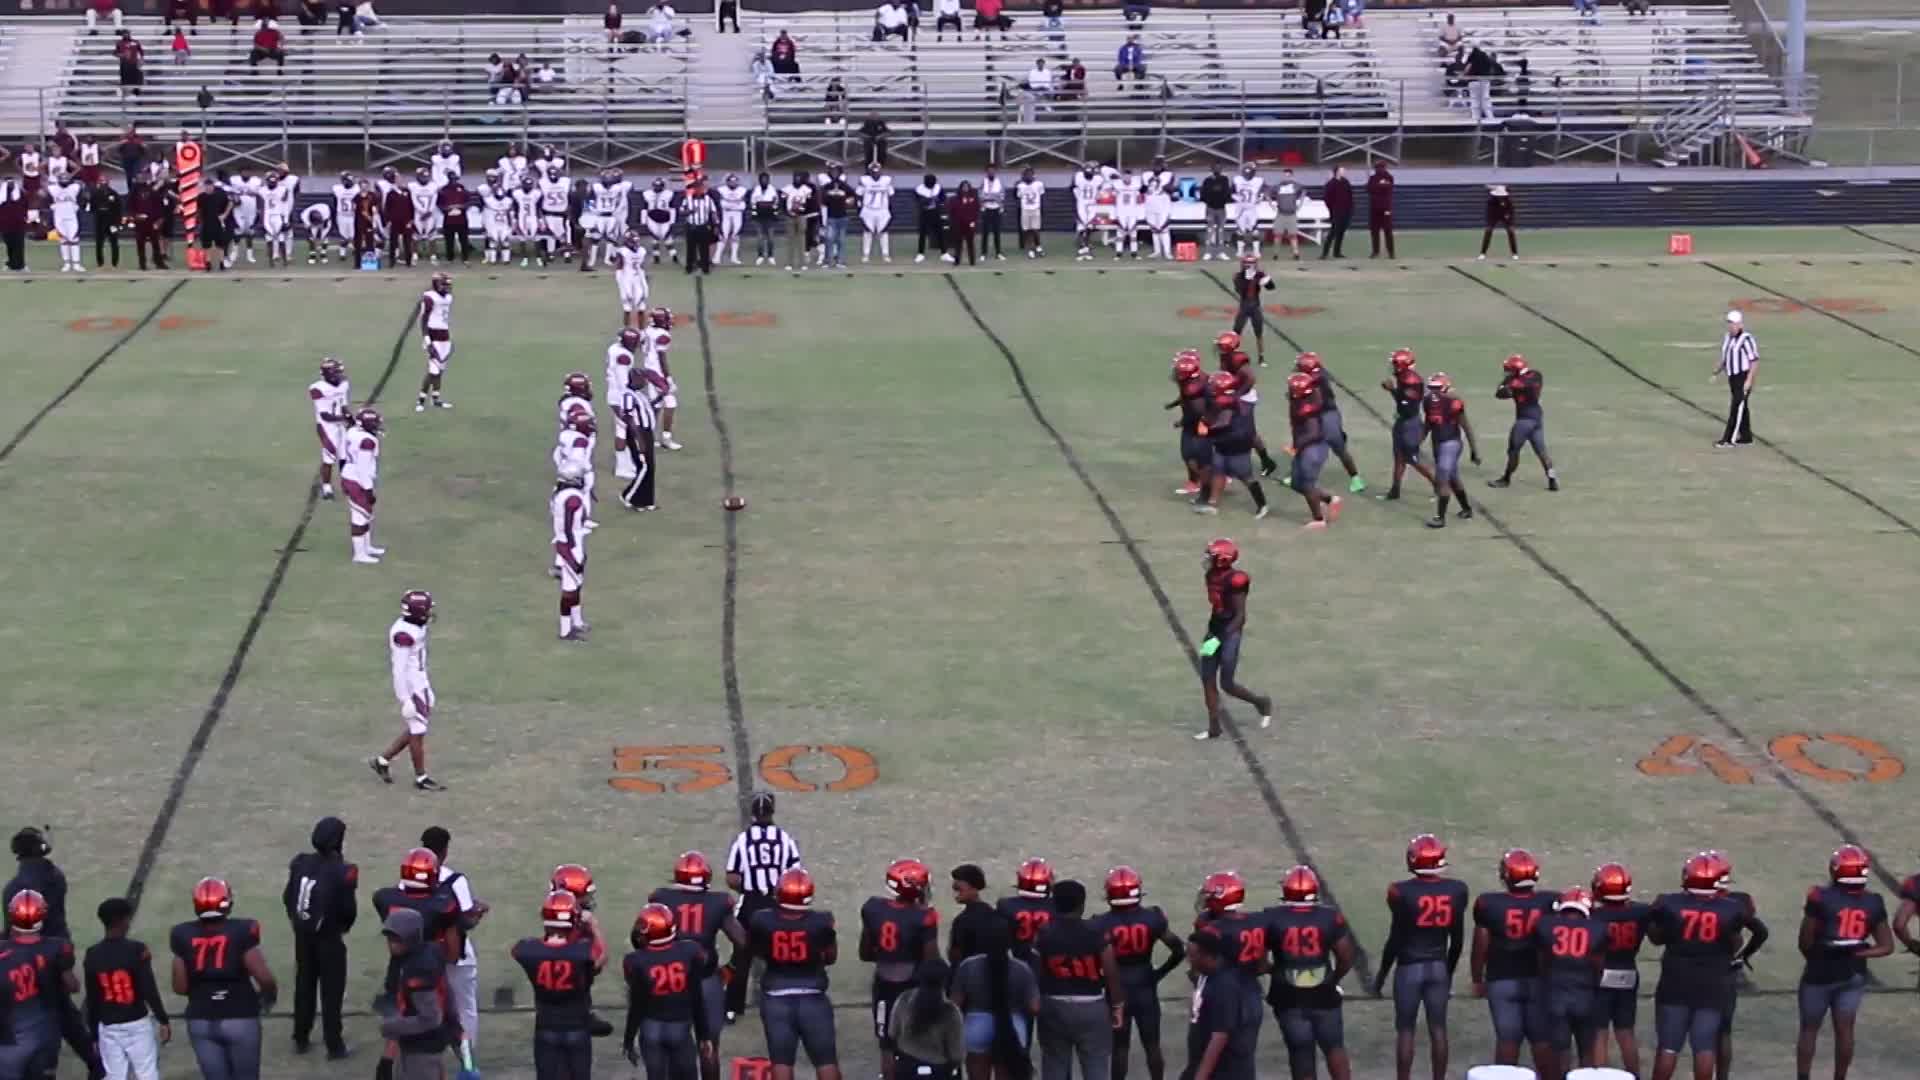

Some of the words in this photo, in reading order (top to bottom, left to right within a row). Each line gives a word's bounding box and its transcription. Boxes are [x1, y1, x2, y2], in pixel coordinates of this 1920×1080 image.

[607, 744, 879, 793] 50
[1634, 733, 1905, 784] 40
[748, 843, 780, 866] 161
[678, 904, 704, 932] 11
[1417, 895, 1451, 928] 25
[1682, 910, 1719, 942] 78
[1838, 908, 1867, 939] 16
[771, 930, 808, 962] 65
[880, 921, 897, 951] 8
[1112, 924, 1149, 955] 20
[1283, 926, 1322, 957] 43
[1552, 926, 1590, 958] 30
[192, 935, 229, 970] 77
[9, 964, 39, 1001] 32
[536, 960, 574, 991] 42
[649, 961, 688, 995] 26
